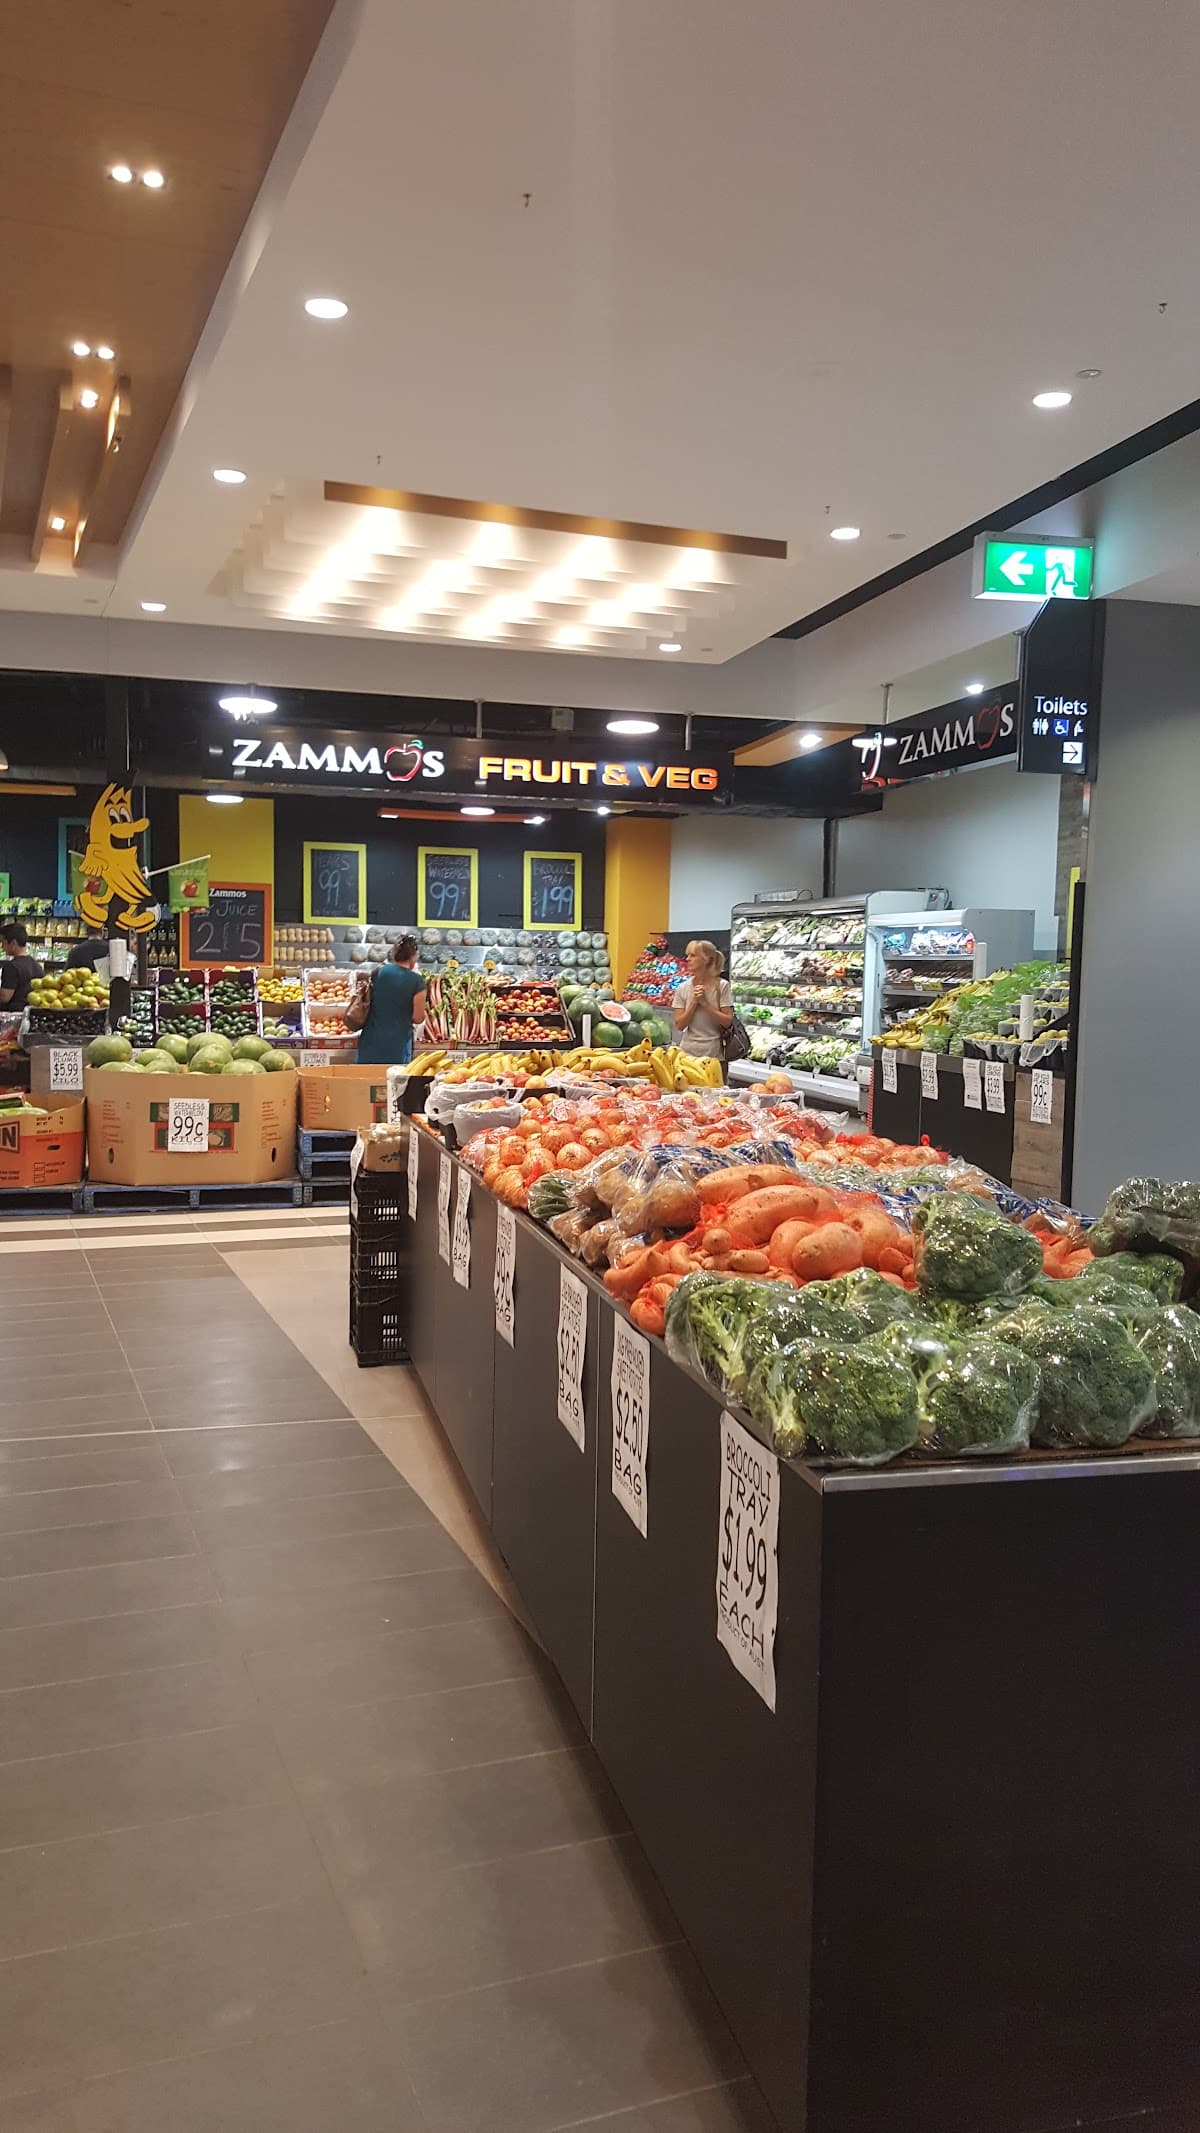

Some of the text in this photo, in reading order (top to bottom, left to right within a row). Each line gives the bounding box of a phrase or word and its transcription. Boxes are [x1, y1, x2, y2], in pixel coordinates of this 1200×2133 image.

[1034, 696, 1088, 716] Toilets
[898, 703, 1014, 765] ZAMMOS
[232, 739, 445, 781] ZAMMOS
[479, 757, 718, 790] FRUIT & VEG
[208, 888, 247, 898] Zammos
[53, 1062, 79, 1080] $5.99
[173, 1102, 205, 1110] SEEDLESS
[453, 1247, 468, 1269] BAG
[559, 1379, 579, 1417] BAG
[616, 1379, 643, 1464] $2.50
[615, 1447, 642, 1496] BAG
[727, 1432, 771, 1503] BROCCOLI
[727, 1465, 769, 1528] TRAY
[722, 1494, 767, 1611] $1.99
[720, 1579, 764, 1660] EACH
